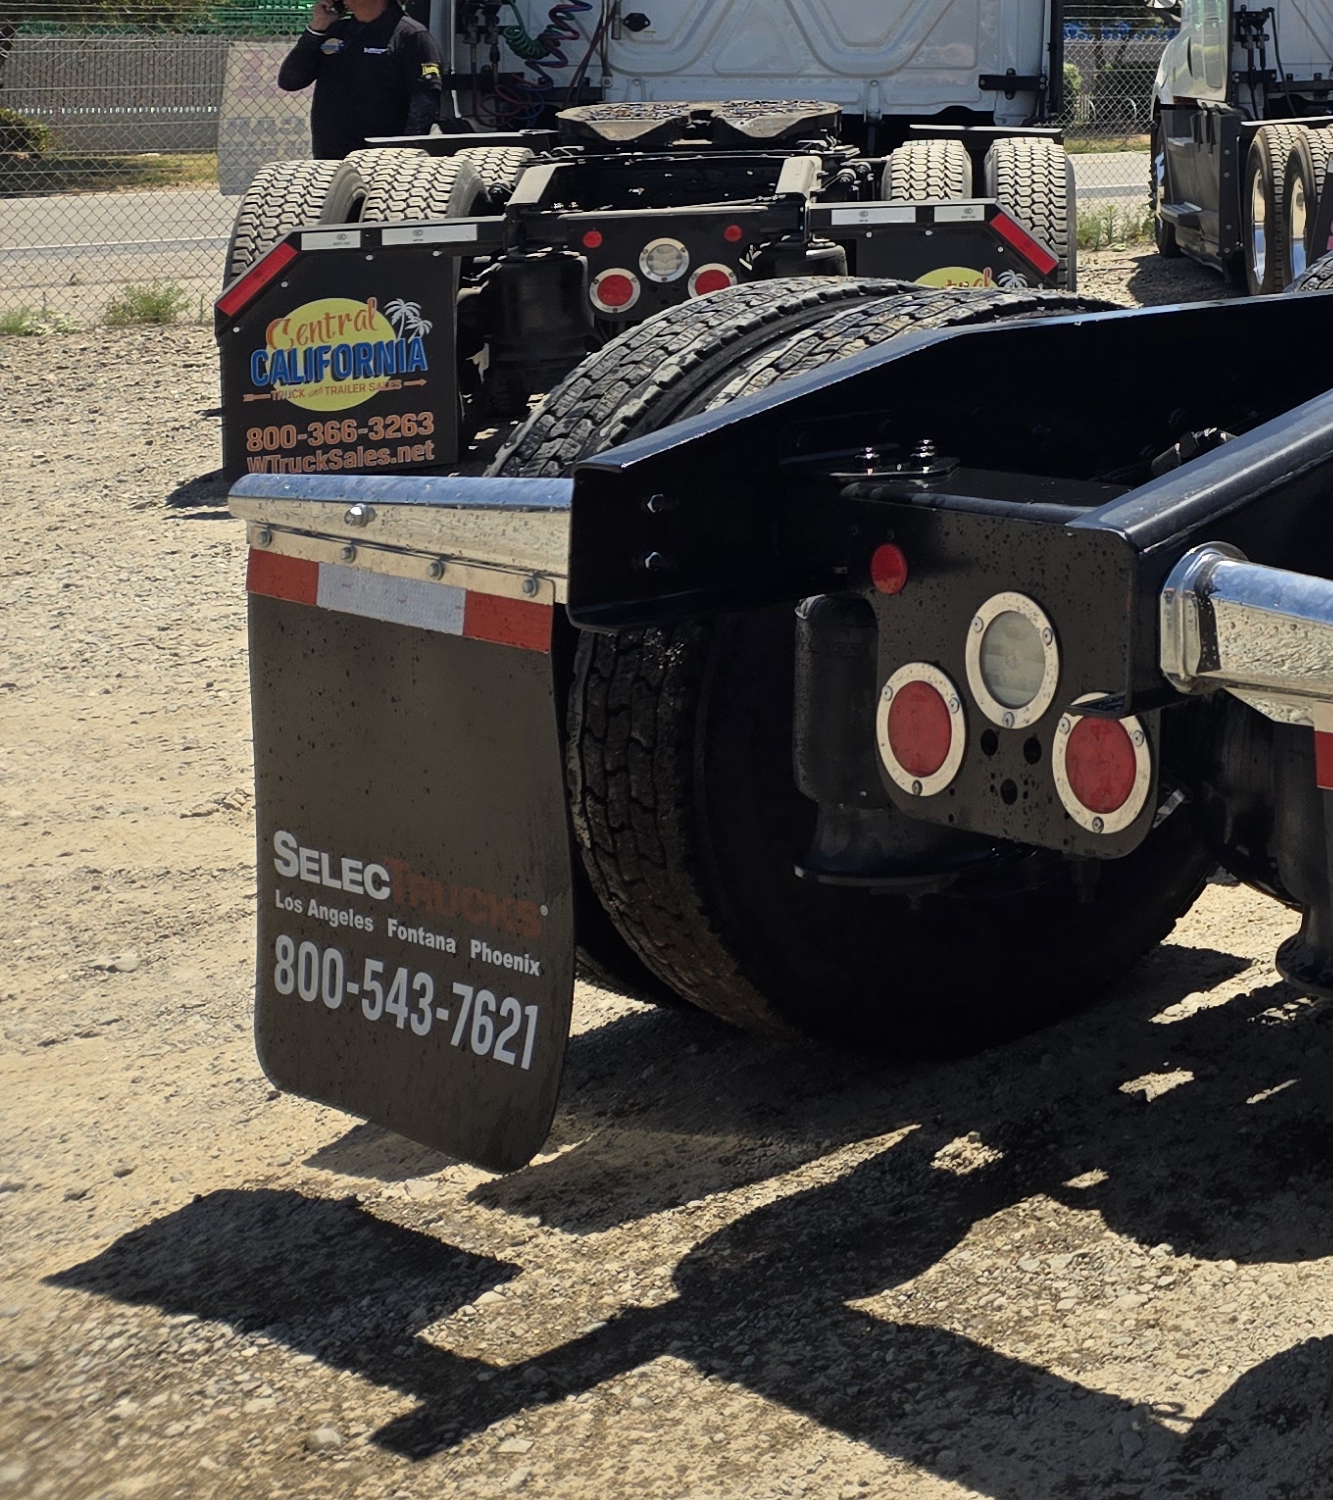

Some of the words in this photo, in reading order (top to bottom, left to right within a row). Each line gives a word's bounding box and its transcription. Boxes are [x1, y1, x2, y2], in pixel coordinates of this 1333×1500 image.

[266, 297, 380, 351] Central
[250, 336, 429, 387] CALIFORNIA
[271, 388, 305, 401] TRUCK
[325, 383, 366, 396] TRAILER
[369, 379, 402, 391] SALES
[246, 412, 434, 452] 800-366-3263
[275, 889, 303, 913] Los
[307, 899, 374, 932] Angeles
[387, 919, 456, 953] Fontana
[470, 939, 540, 976] Phoenix
[273, 934, 539, 1070] 800-543-7621
